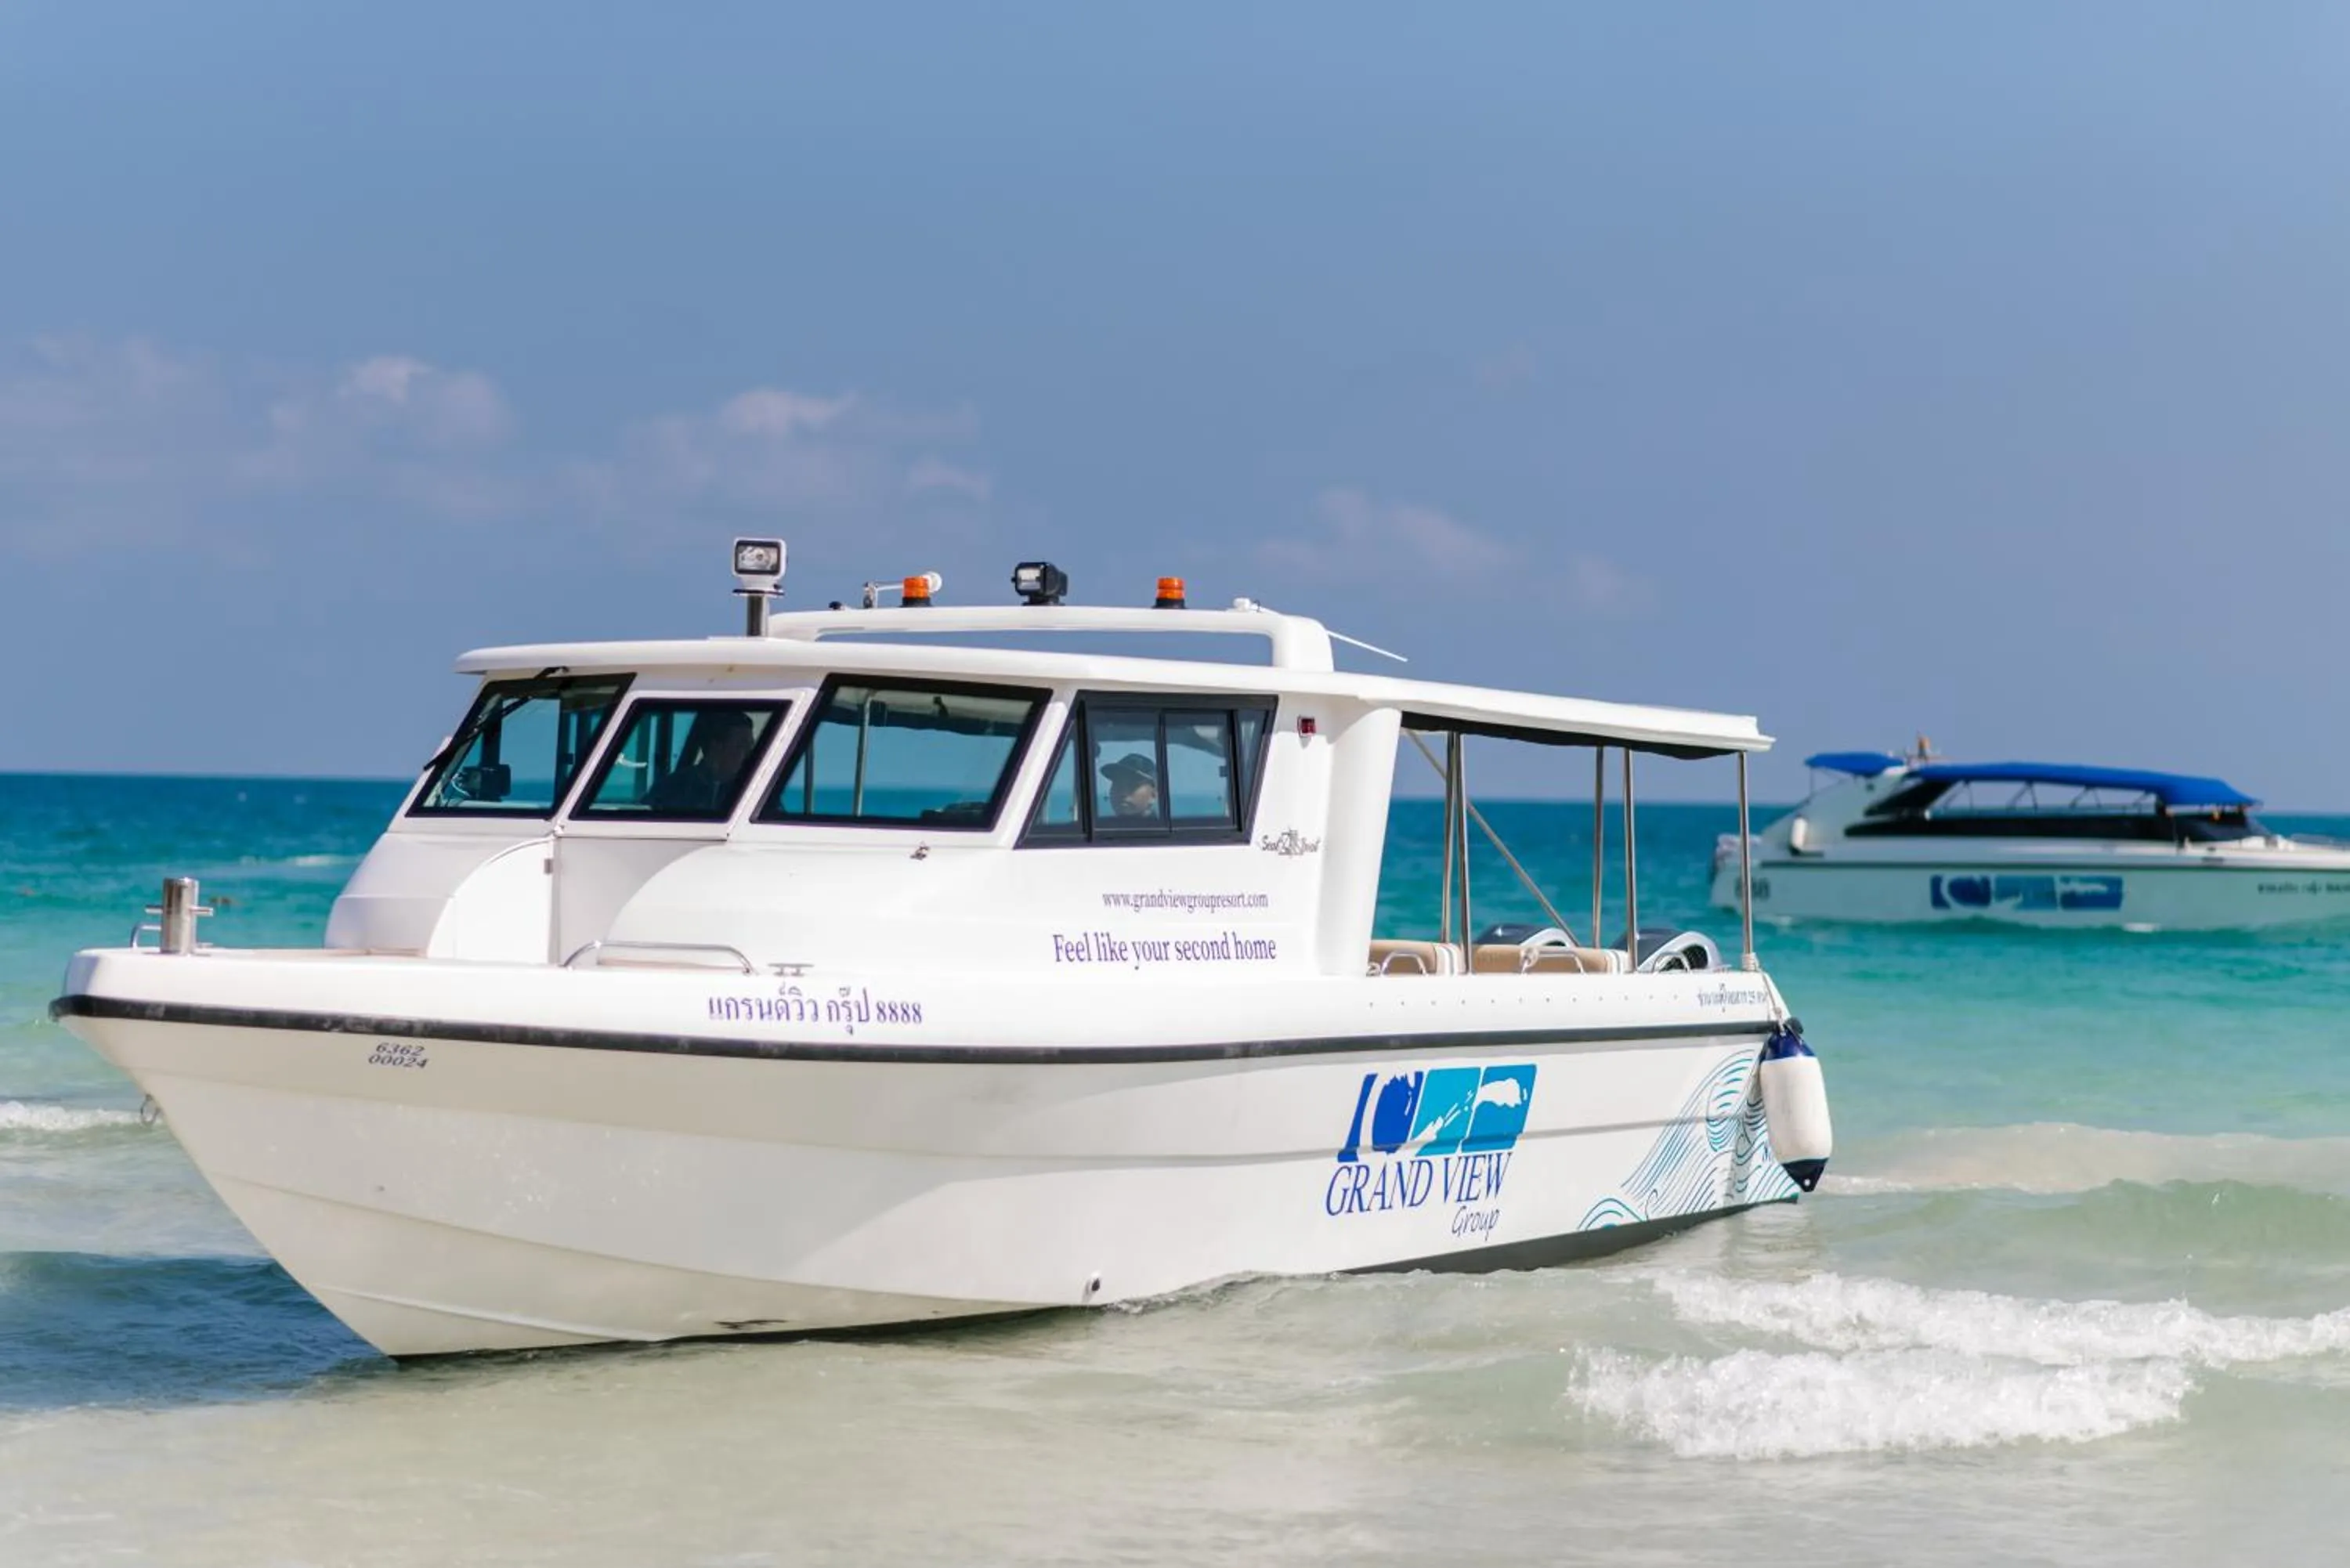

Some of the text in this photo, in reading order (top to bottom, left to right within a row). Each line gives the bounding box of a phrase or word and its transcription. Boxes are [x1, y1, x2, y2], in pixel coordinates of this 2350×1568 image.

[1102, 890, 1268, 913] www.grandviewgroupresort.com
[1053, 931, 1276, 970] Feel like your second home
[709, 981, 922, 1035] แกรนด์วิว กรุ๊ป 8888
[368, 1054, 428, 1068] 00024
[376, 1042, 425, 1057] 6362
[1325, 1151, 1513, 1216] GRAND VIEW
[1451, 1205, 1500, 1241] Group
